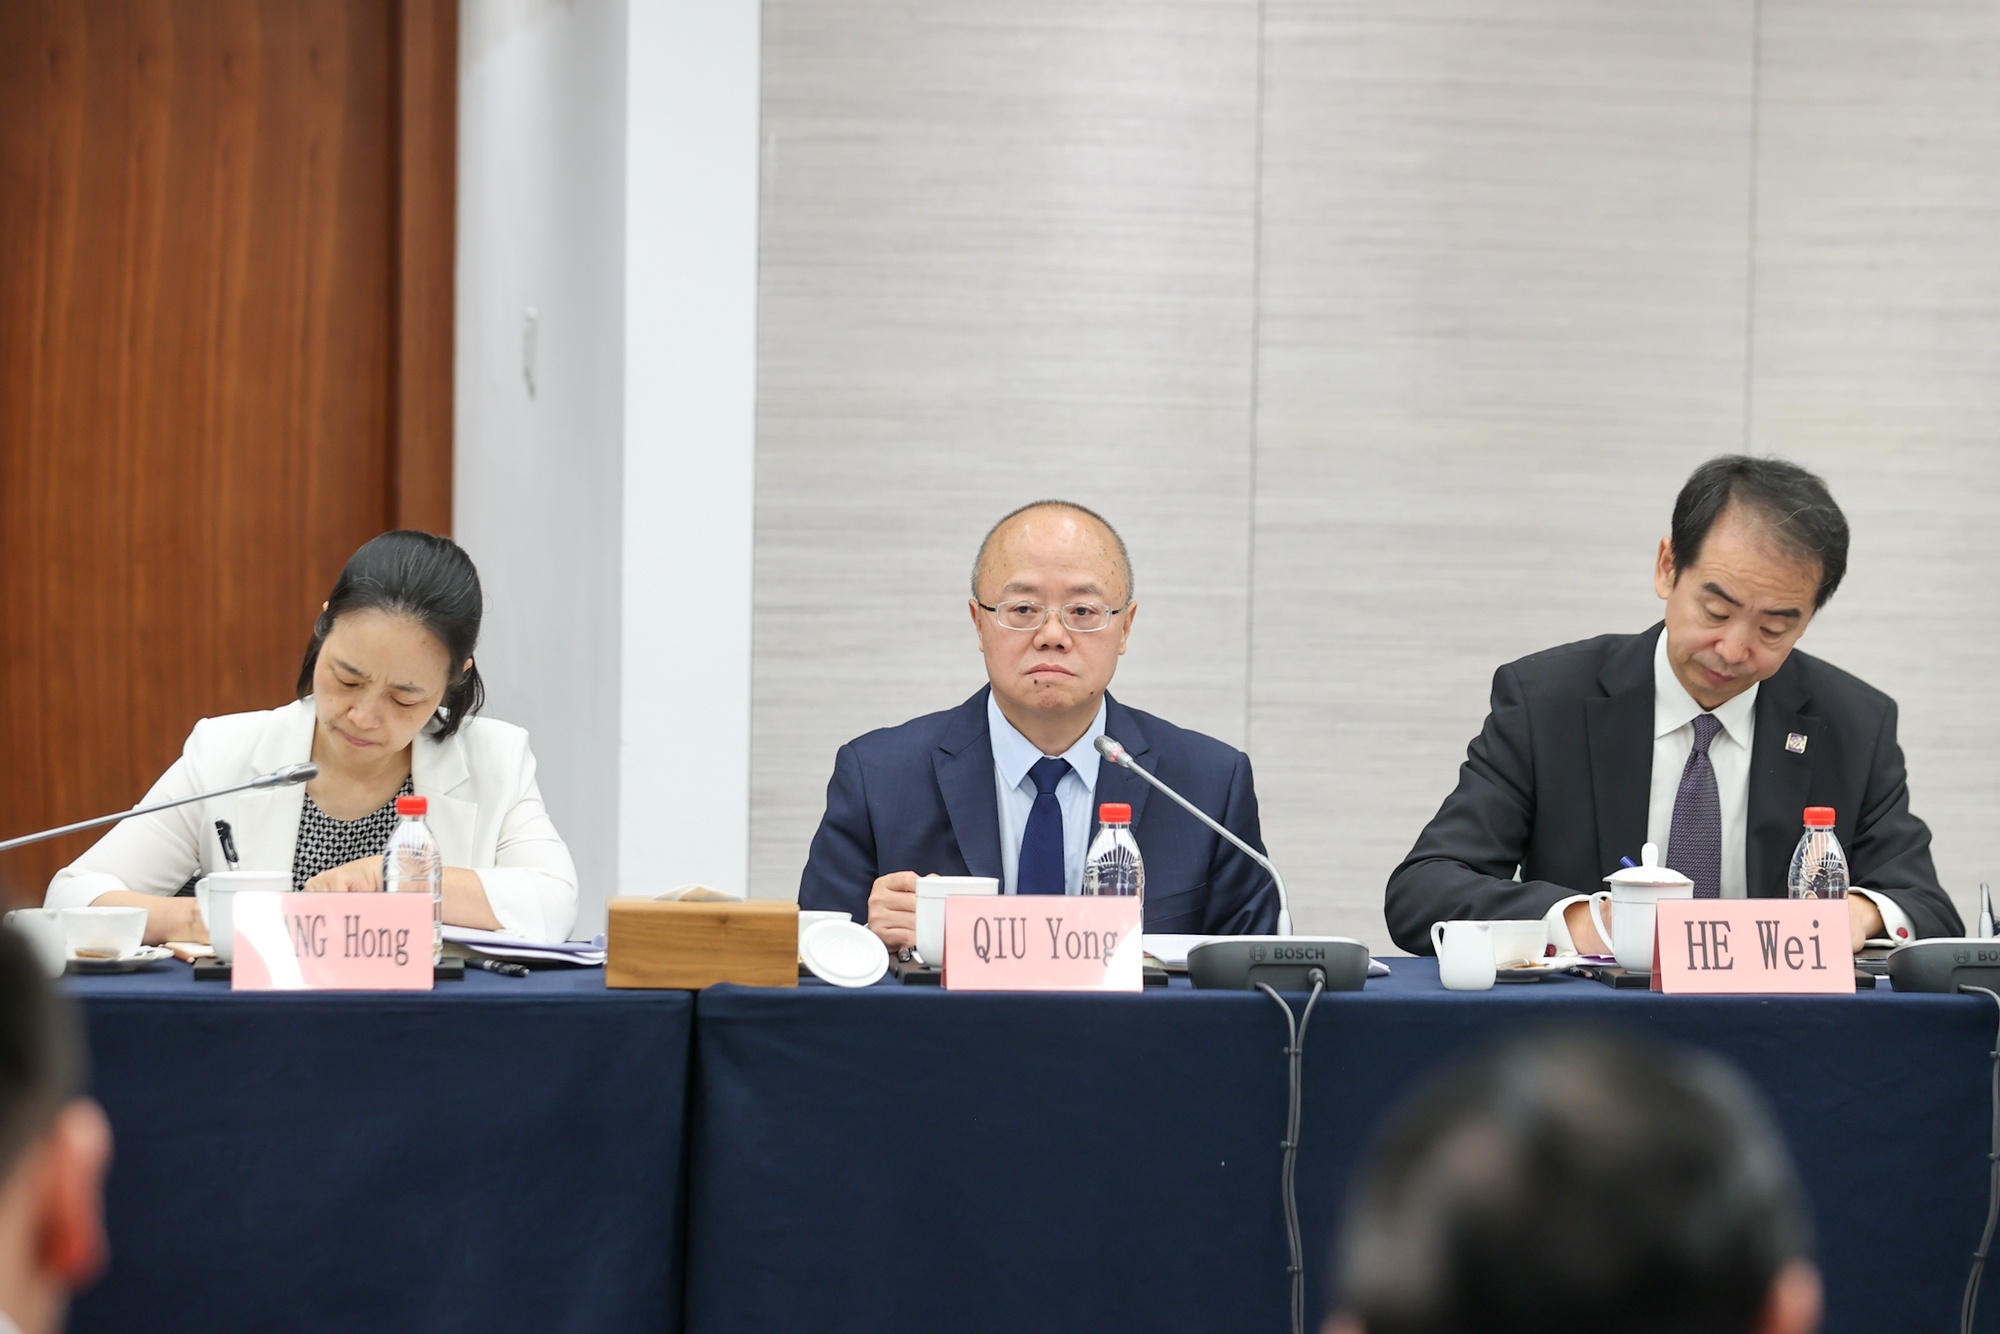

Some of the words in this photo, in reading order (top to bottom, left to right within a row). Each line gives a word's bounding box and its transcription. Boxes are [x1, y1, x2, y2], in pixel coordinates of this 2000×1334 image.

[344, 914, 410, 966] Hong
[973, 916, 1027, 964] QIU
[1045, 917, 1119, 968] Yong
[1273, 947, 1326, 960] BOSCH
[1684, 920, 1734, 971] HE
[1755, 919, 1827, 970] Wei
[1977, 950, 2000, 962] BO
